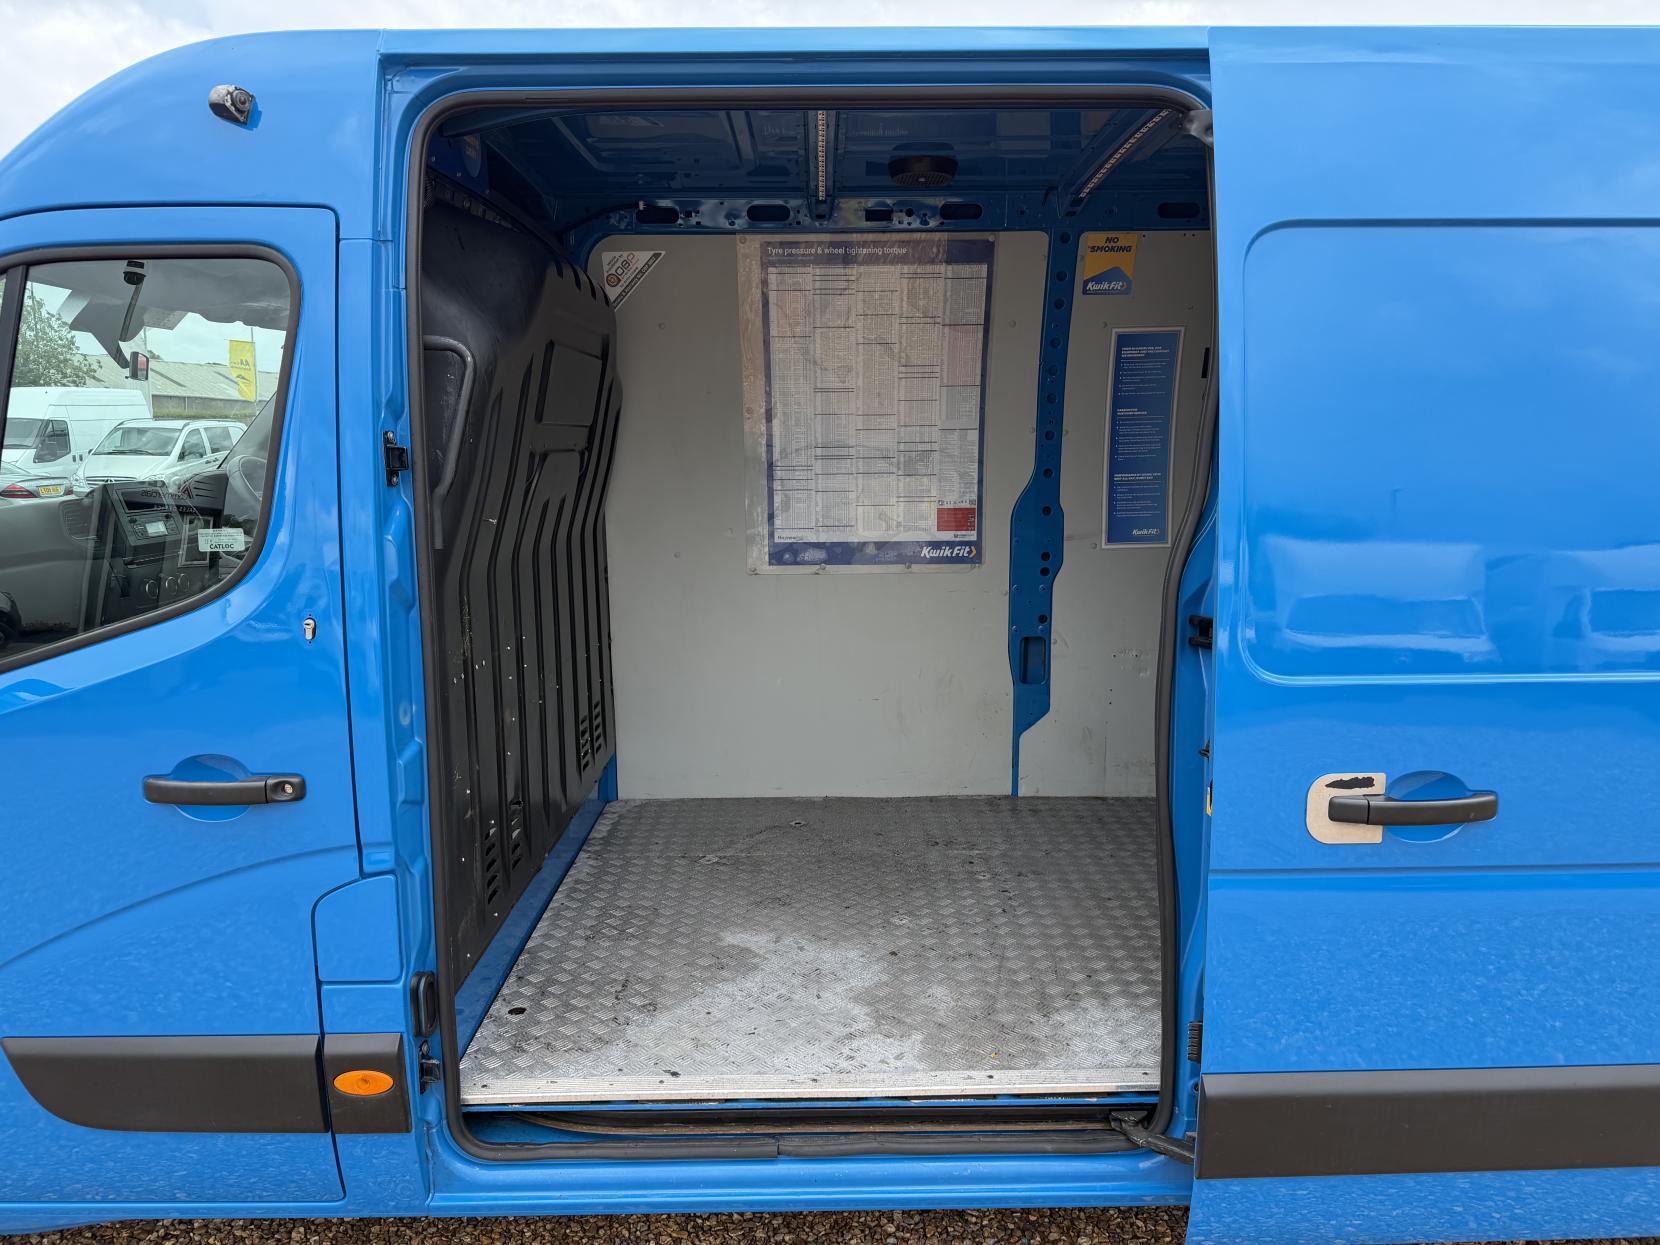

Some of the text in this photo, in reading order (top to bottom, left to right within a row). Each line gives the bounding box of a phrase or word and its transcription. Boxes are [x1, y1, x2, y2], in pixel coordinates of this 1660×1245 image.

[1104, 236, 1120, 244] NO
[768, 246, 908, 257] Tyre pressure & wheel tightening torque
[1090, 245, 1133, 253] SMOKING
